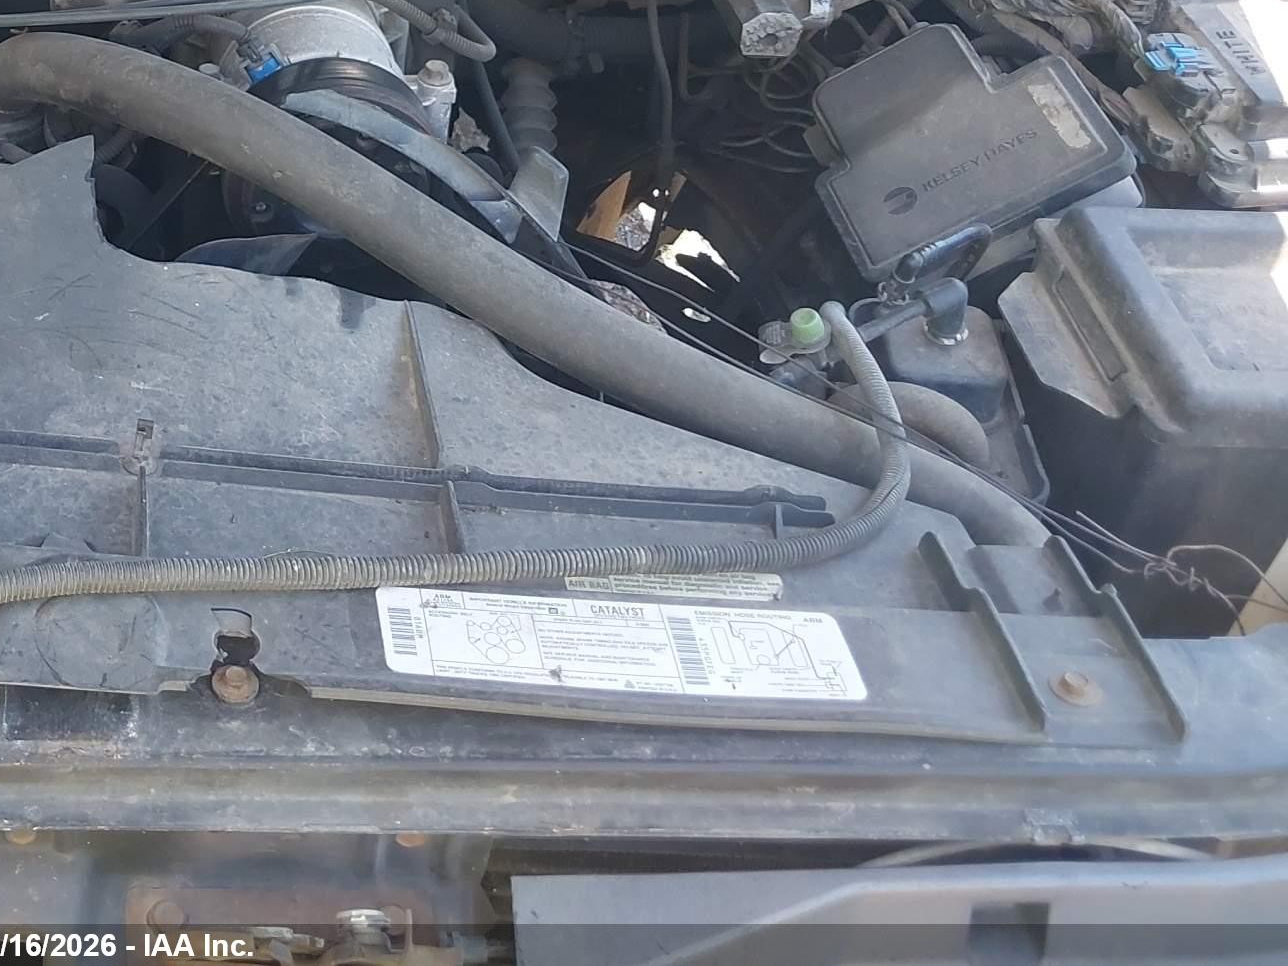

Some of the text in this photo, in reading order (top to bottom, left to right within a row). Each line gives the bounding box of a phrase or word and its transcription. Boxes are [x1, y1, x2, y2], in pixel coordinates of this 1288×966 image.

[1216, 30, 1266, 75] WHITE
[921, 129, 1038, 192] KELSEY HAYES
[568, 580, 609, 590] AIR BAG
[590, 605, 644, 617] CATALYST
